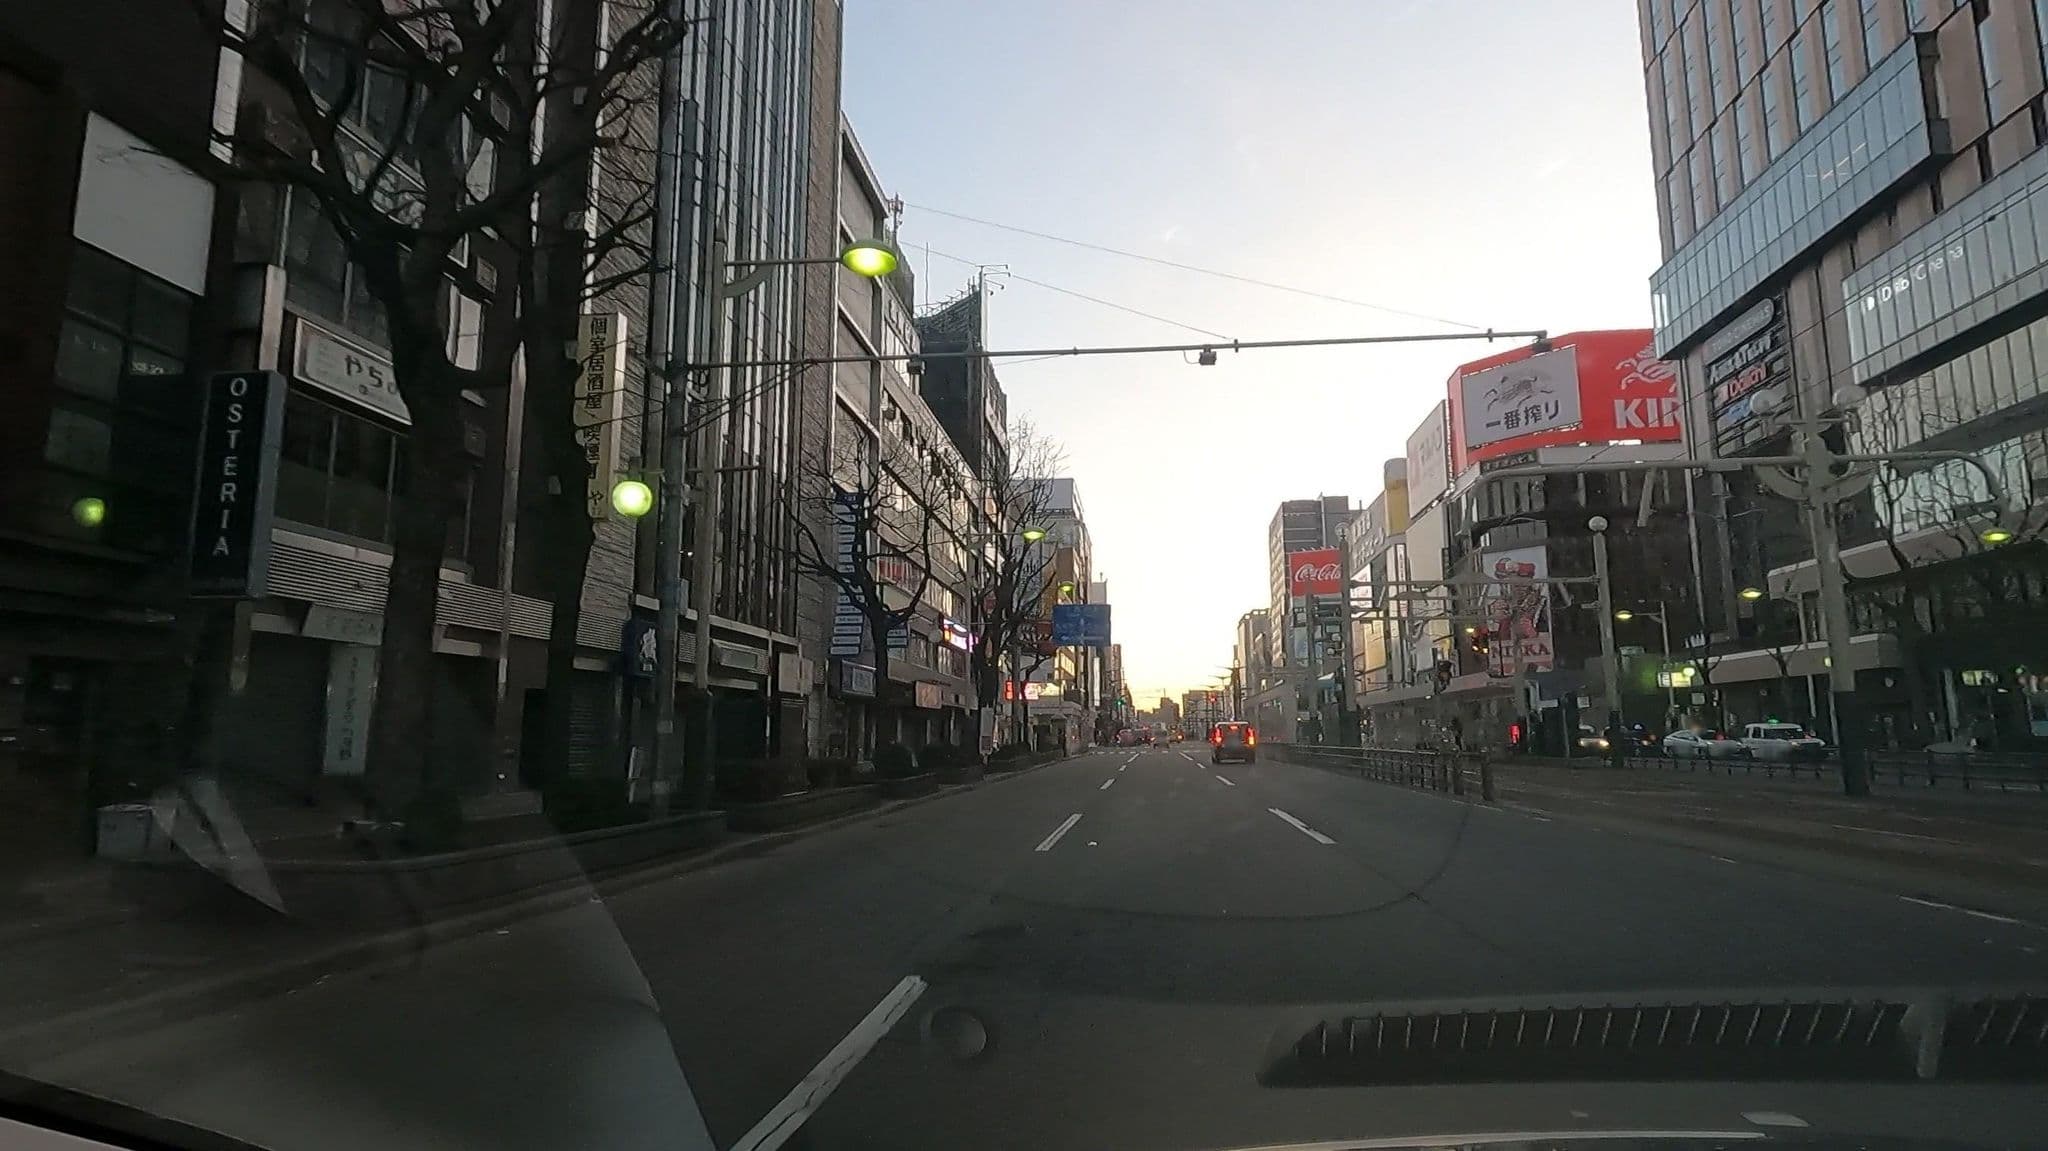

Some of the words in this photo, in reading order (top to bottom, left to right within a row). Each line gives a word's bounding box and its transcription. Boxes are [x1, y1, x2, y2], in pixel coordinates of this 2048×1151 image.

[1486, 400, 1559, 429] 一番搾り
[213, 377, 248, 556] OSTERIA
[1490, 643, 1551, 659] NIKA
